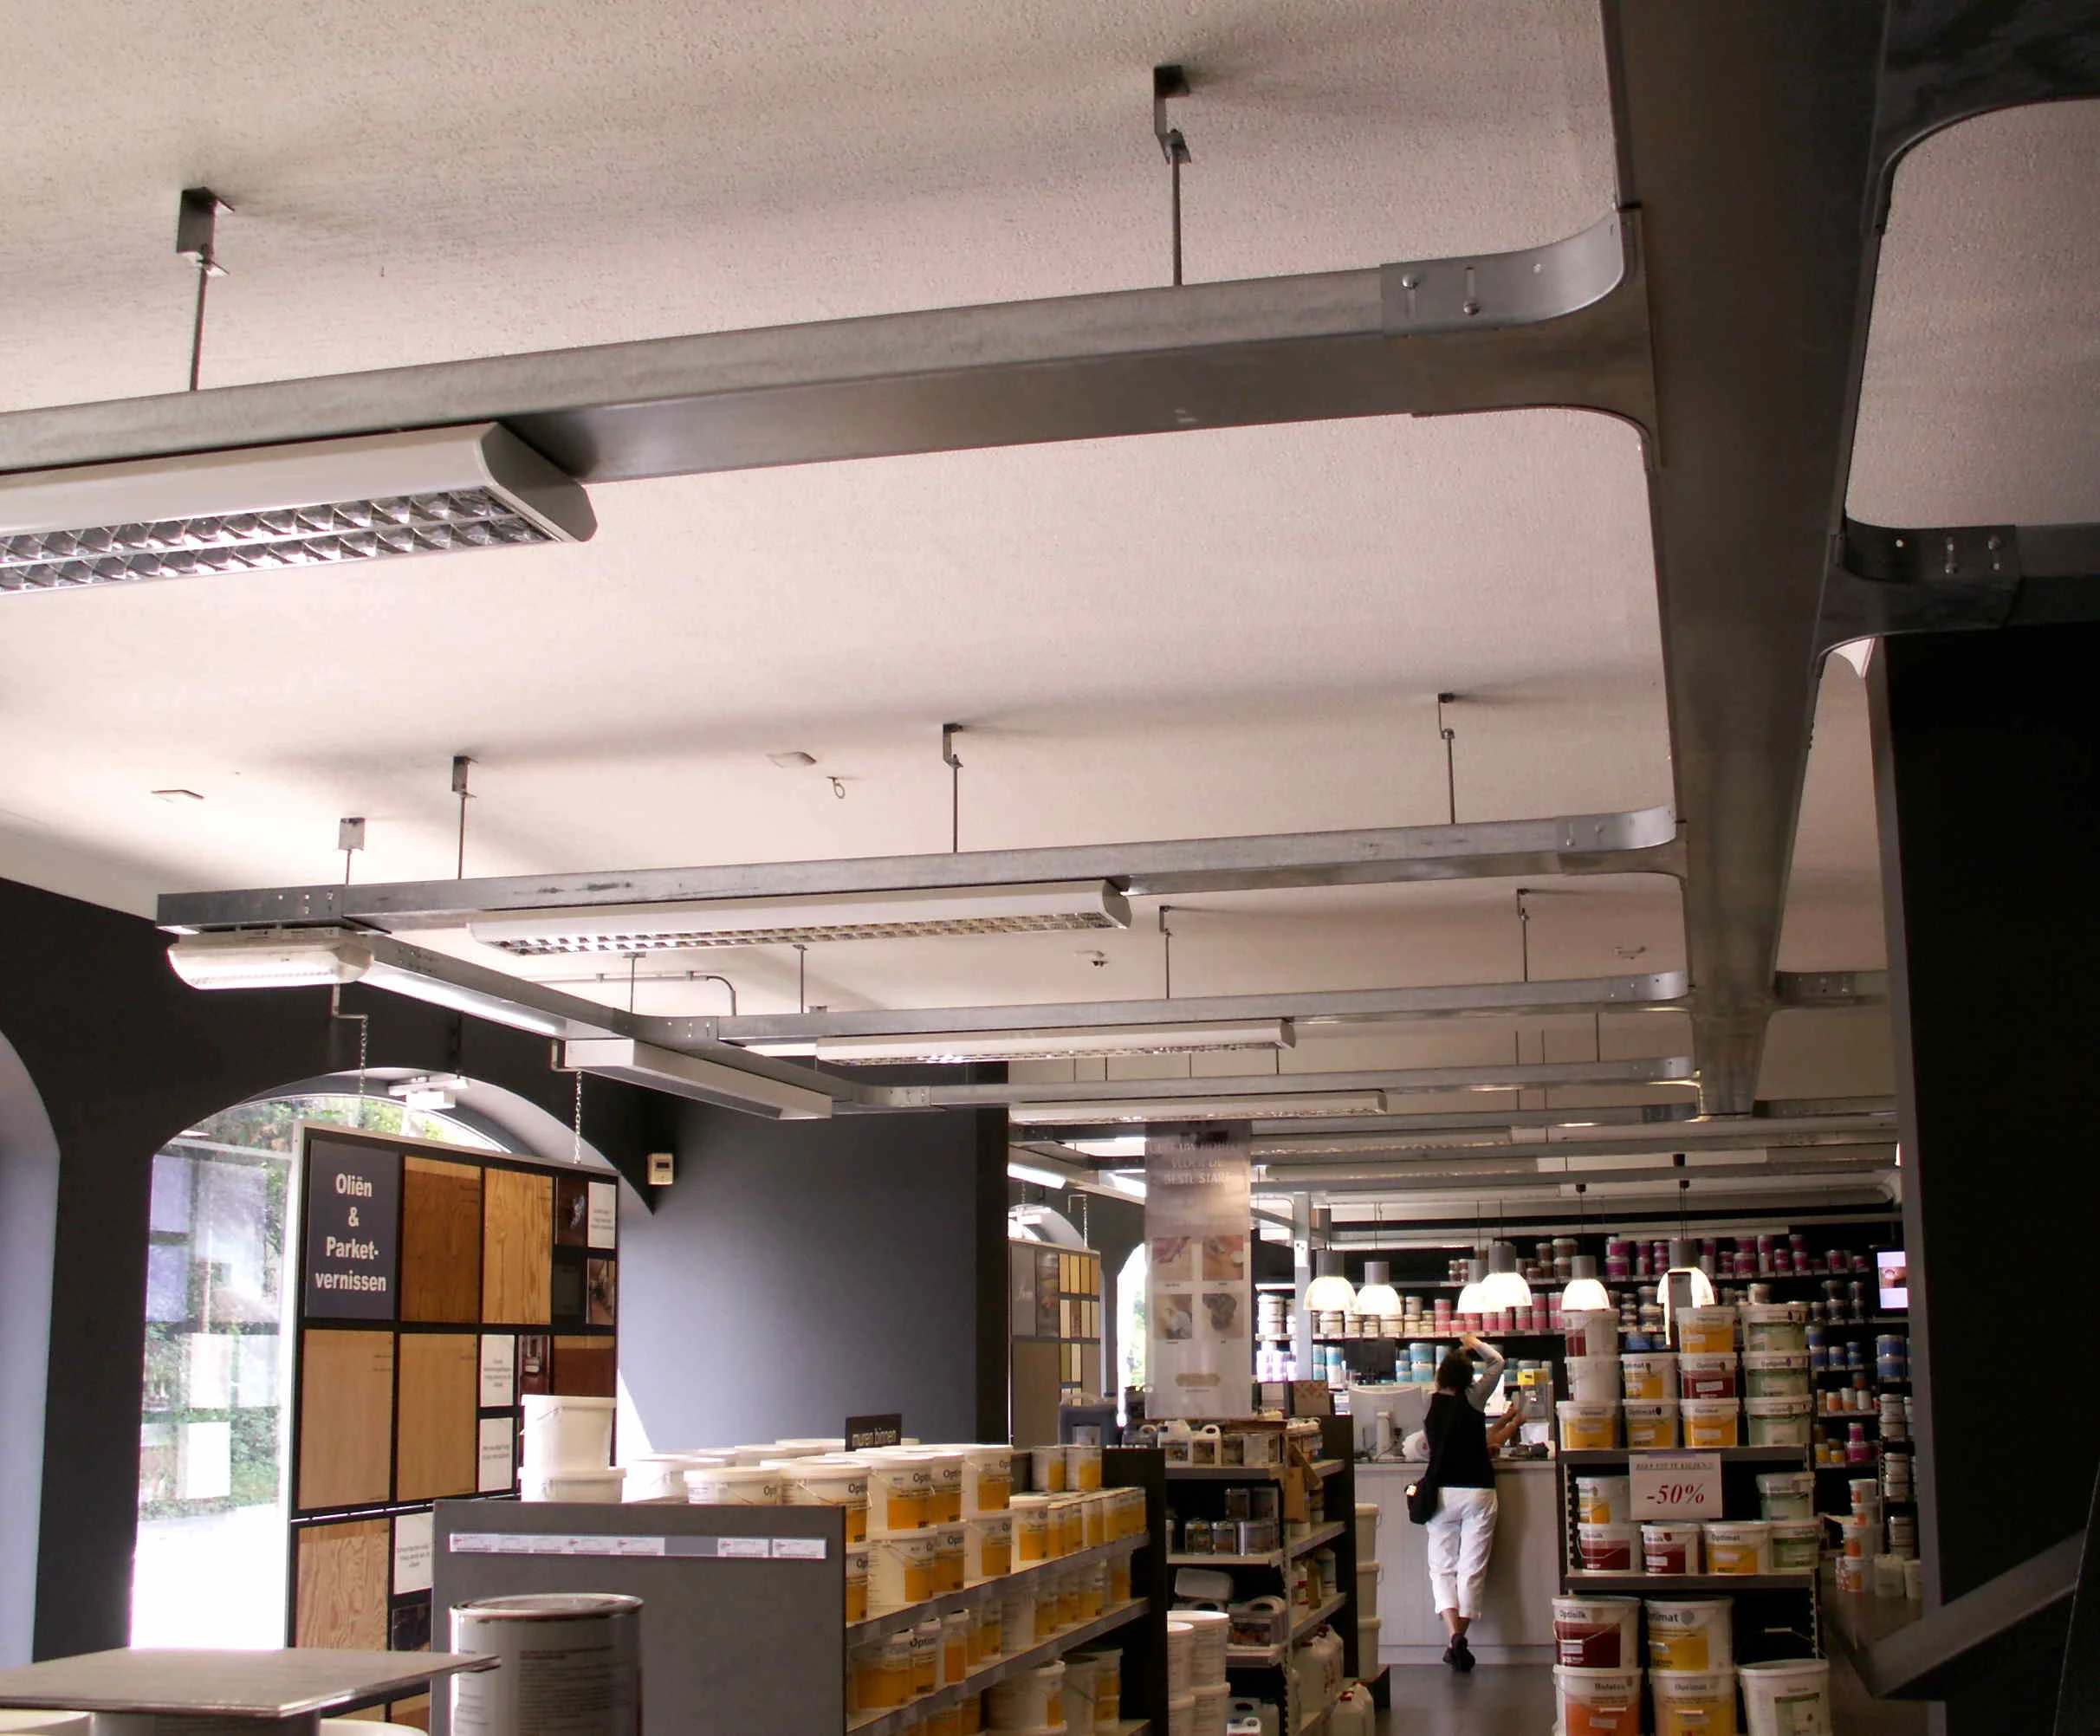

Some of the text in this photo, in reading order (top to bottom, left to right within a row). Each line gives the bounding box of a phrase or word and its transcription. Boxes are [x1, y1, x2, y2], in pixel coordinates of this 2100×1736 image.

[335, 1173, 373, 1197] Oliën
[348, 1206, 360, 1227] &
[326, 1236, 379, 1260] Parket-
[314, 1270, 387, 1292] vernissen
[874, 1428, 897, 1445] binnen
[1647, 1482, 1705, 1505] -50%
